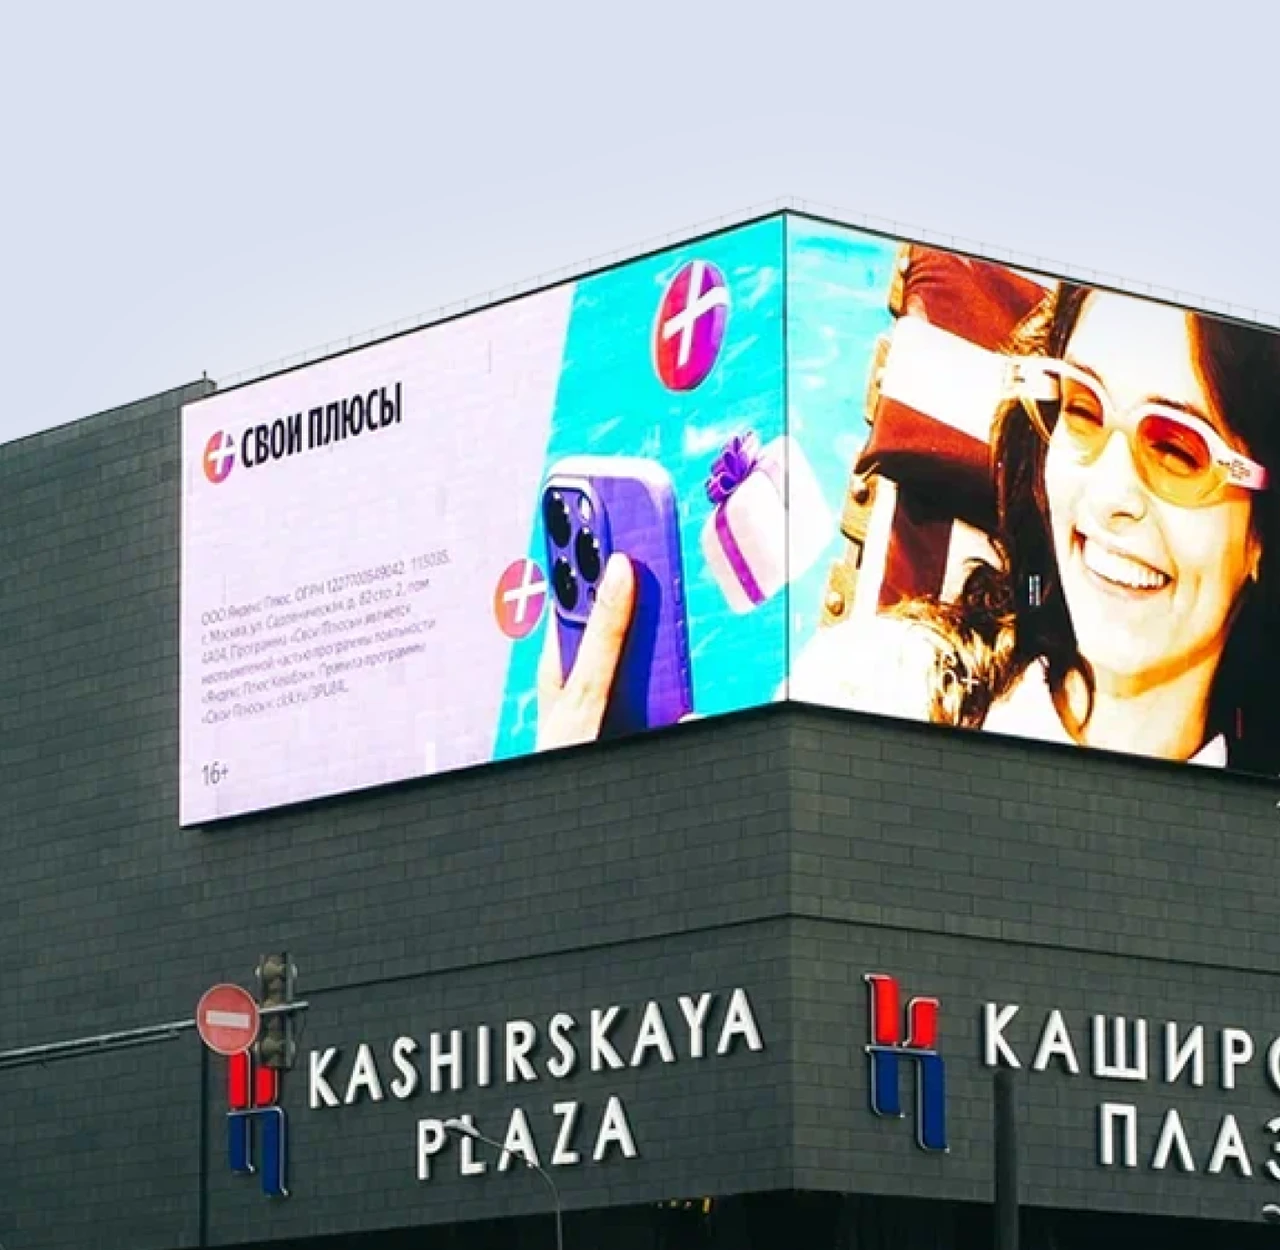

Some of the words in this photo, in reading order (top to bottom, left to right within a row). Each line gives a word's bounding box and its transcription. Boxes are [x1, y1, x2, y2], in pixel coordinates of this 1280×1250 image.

[241, 412, 303, 468] СВОИ
[308, 381, 403, 450] ПЛЮСЫ
[201, 760, 229, 786] 16+
[308, 987, 764, 1109] KASHIRSKAYA
[417, 1096, 638, 1181] PLAZA
